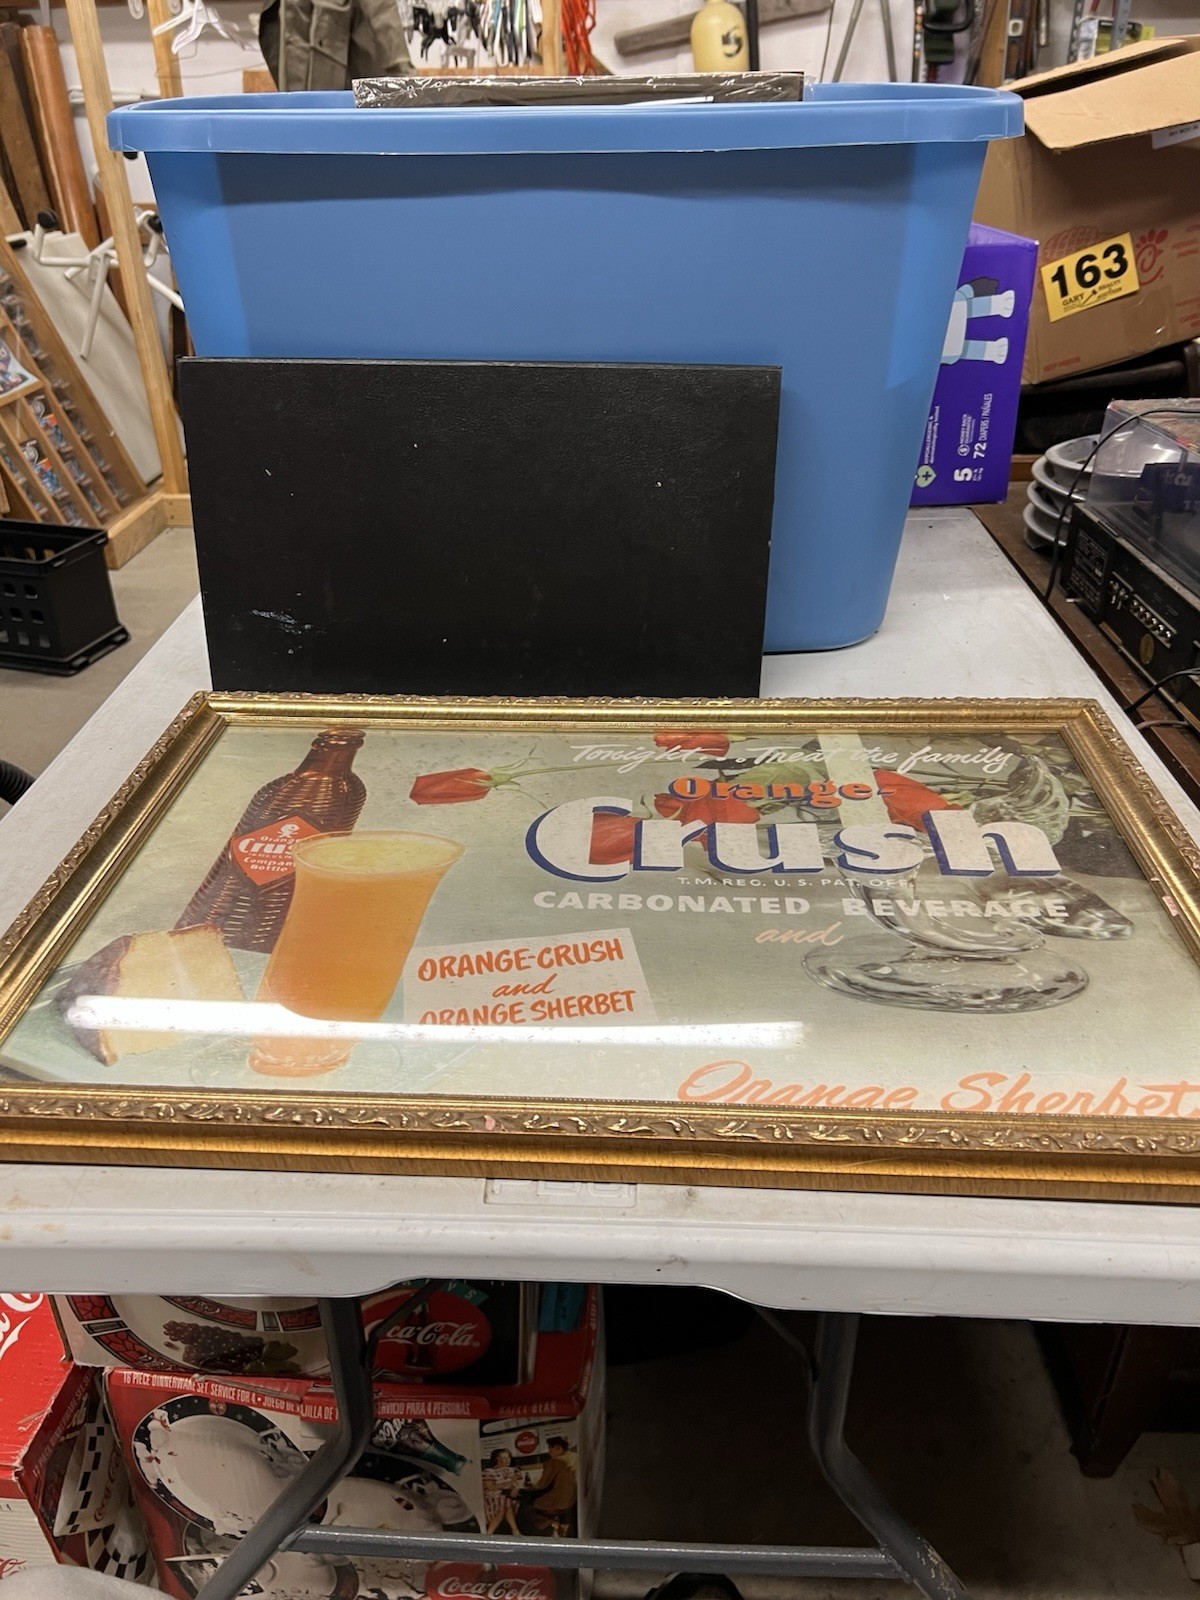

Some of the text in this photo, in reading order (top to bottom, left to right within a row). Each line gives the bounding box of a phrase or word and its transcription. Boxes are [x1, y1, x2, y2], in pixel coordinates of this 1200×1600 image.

[1051, 243, 1128, 298] 163
[1062, 292, 1085, 306] GARY
[978, 420, 989, 441] DIAPERS
[973, 442, 987, 459] 72
[953, 467, 972, 481] 5
[897, 746, 1013, 774] family
[238, 838, 294, 855] Crus
[525, 796, 1062, 883] Crush
[250, 864, 288, 872] Bottle
[533, 890, 1070, 918] CARBONATED BEVERAGE
[755, 921, 846, 946] and
[417, 938, 624, 981] ORANGE-CRUSH
[492, 973, 558, 998] and
[530, 990, 638, 1022] SHERBET
[677, 1058, 1200, 1118] Orange Sherbet
[123, 1371, 132, 1384] 16
[132, 1372, 151, 1386] PIECE
[151, 1374, 196, 1391] DINNERWARE
[210, 1383, 236, 1401] SERVICE
[237, 1388, 249, 1403] FOR
[263, 1396, 285, 1410] JUEGO
[324, 1408, 334, 1420] DE
[405, 1401, 425, 1415] PARA
[432, 1401, 471, 1416] PERSONAS
[437, 1576, 544, 1600] Coca-Cola
